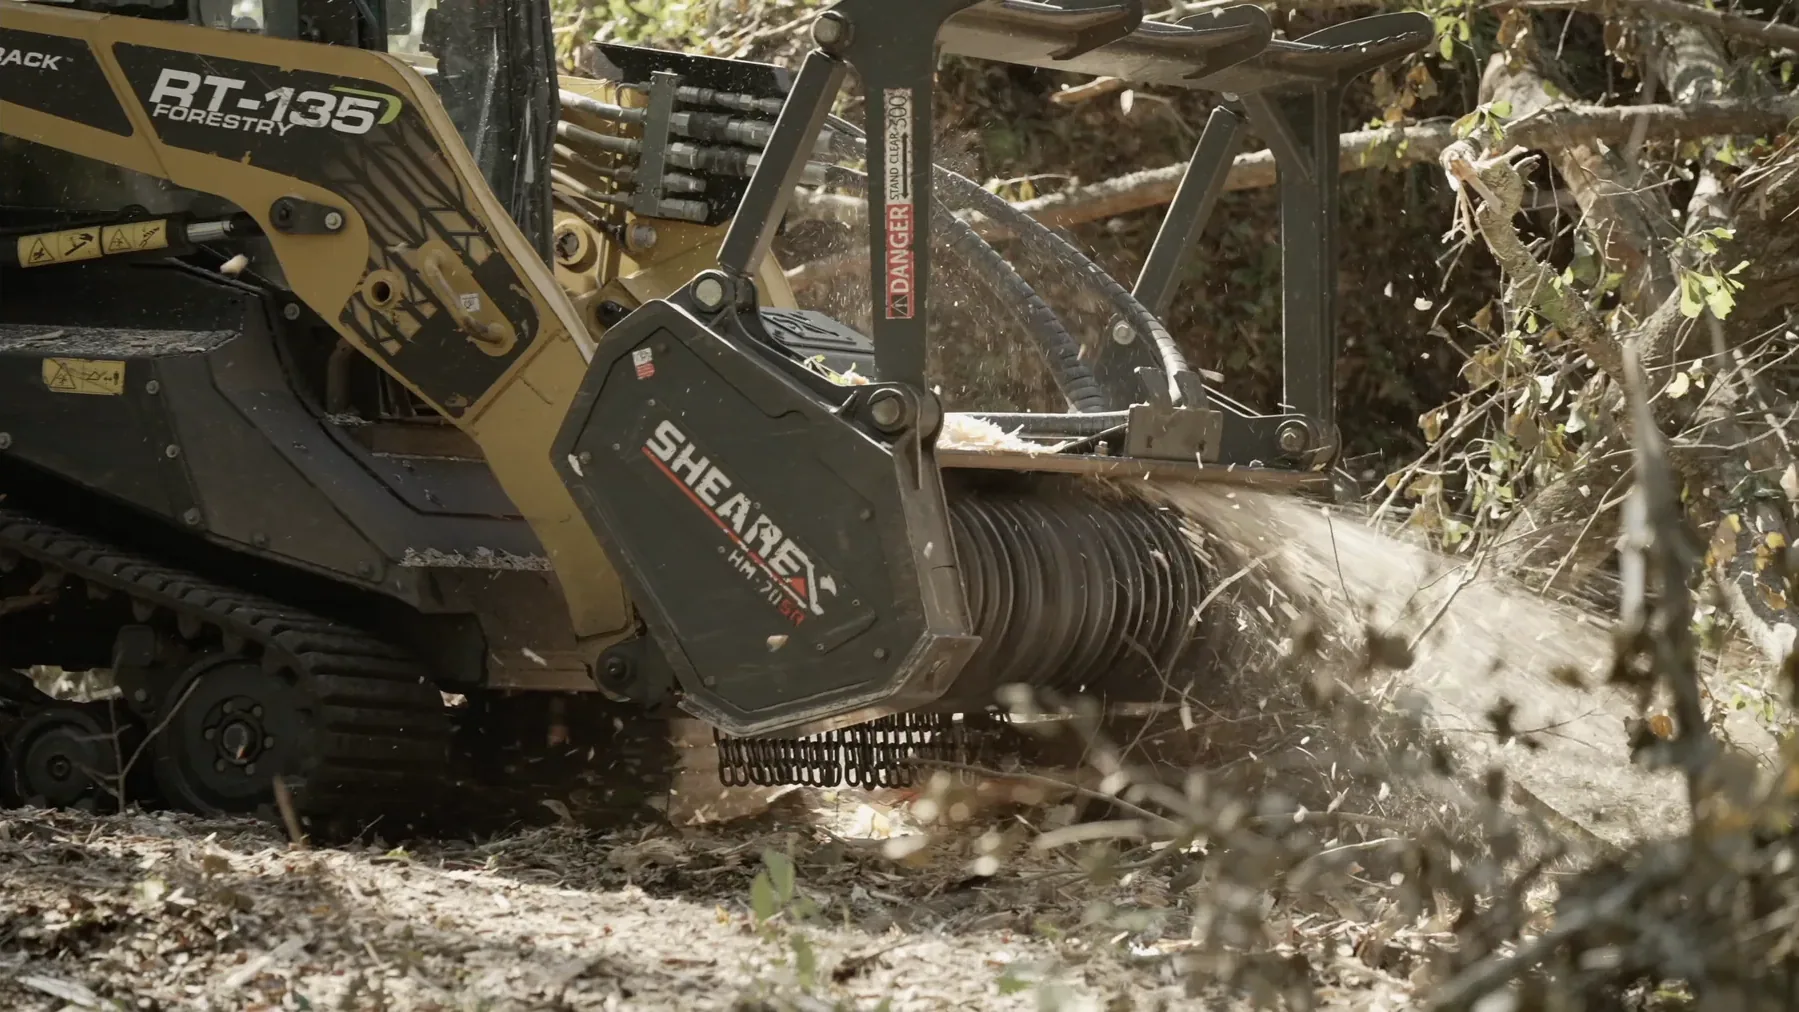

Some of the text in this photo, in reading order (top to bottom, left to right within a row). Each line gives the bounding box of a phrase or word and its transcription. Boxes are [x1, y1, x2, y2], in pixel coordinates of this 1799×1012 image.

[0, 47, 62, 71] ACK
[149, 68, 380, 134] RT-135
[153, 104, 294, 137] FORESTRY
[889, 132, 900, 164] CLEAR
[889, 167, 900, 200] STAND
[889, 206, 909, 293] DANGER
